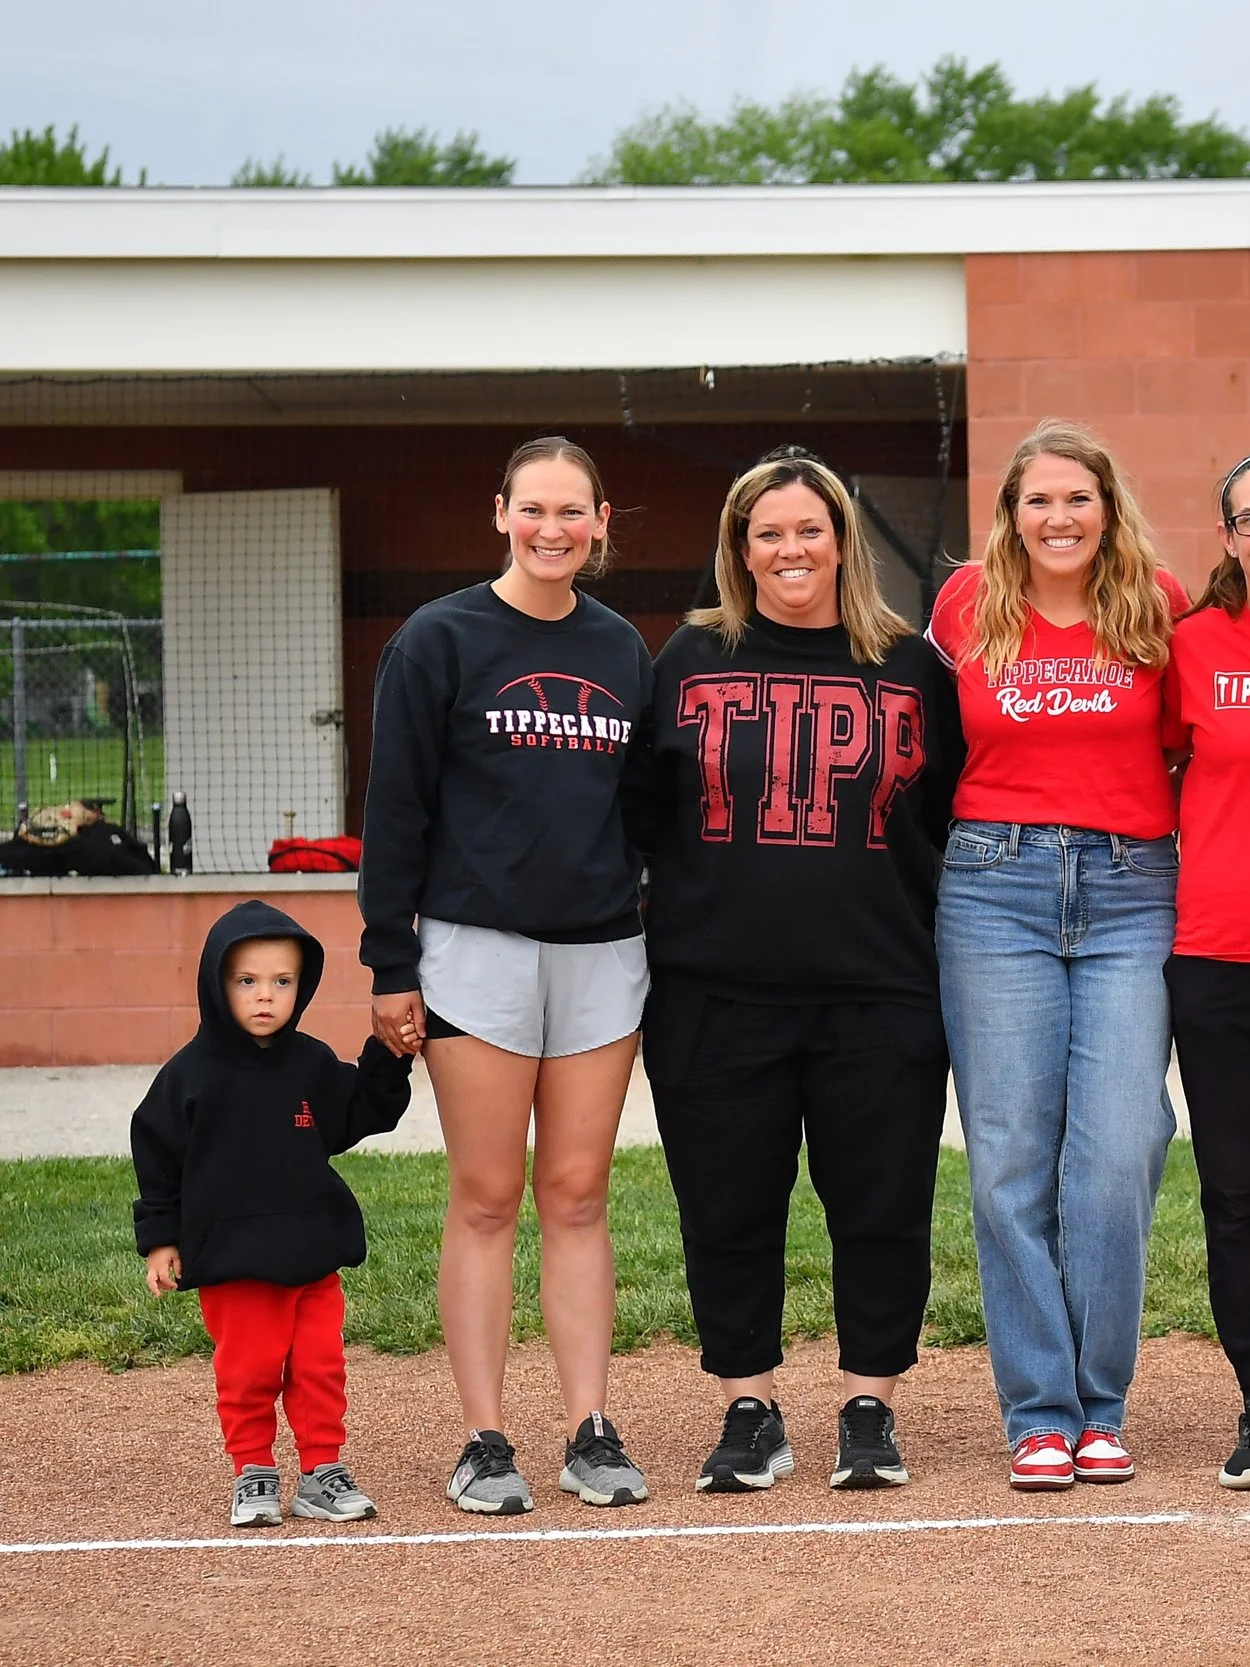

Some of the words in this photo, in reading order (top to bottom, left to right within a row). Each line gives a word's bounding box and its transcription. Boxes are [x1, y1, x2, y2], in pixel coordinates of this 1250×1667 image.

[995, 687, 1045, 722] Red
[1045, 687, 1118, 716] Devils
[485, 709, 632, 744] TIPPECANOE
[511, 734, 616, 754] SOFTBALL
